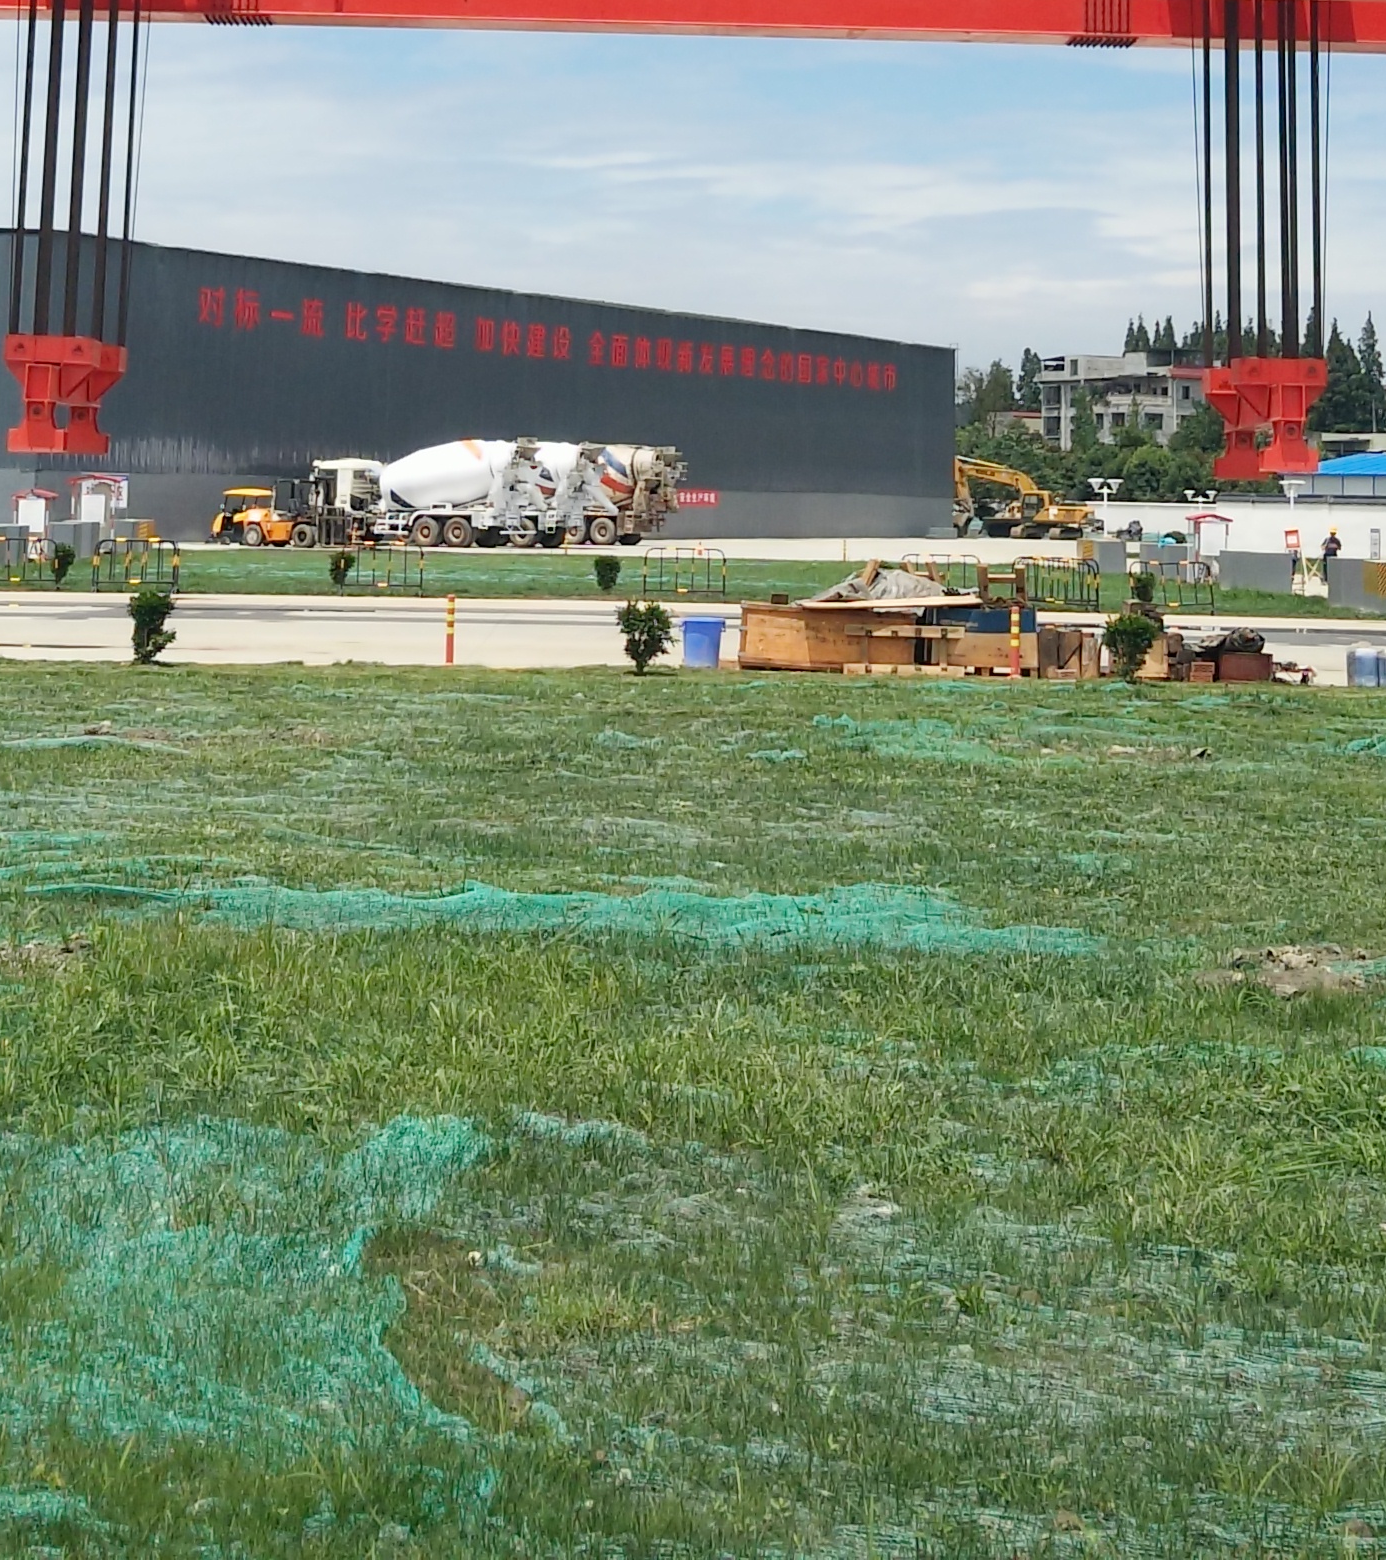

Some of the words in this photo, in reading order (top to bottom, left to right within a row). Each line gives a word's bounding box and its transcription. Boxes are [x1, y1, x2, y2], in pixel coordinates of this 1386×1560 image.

[199, 286, 324, 337] 对标一流
[345, 302, 456, 350] 比学赶超
[476, 316, 572, 361] 加快建设
[587, 329, 897, 390] 全面体现新发展理念的国家中心城市
